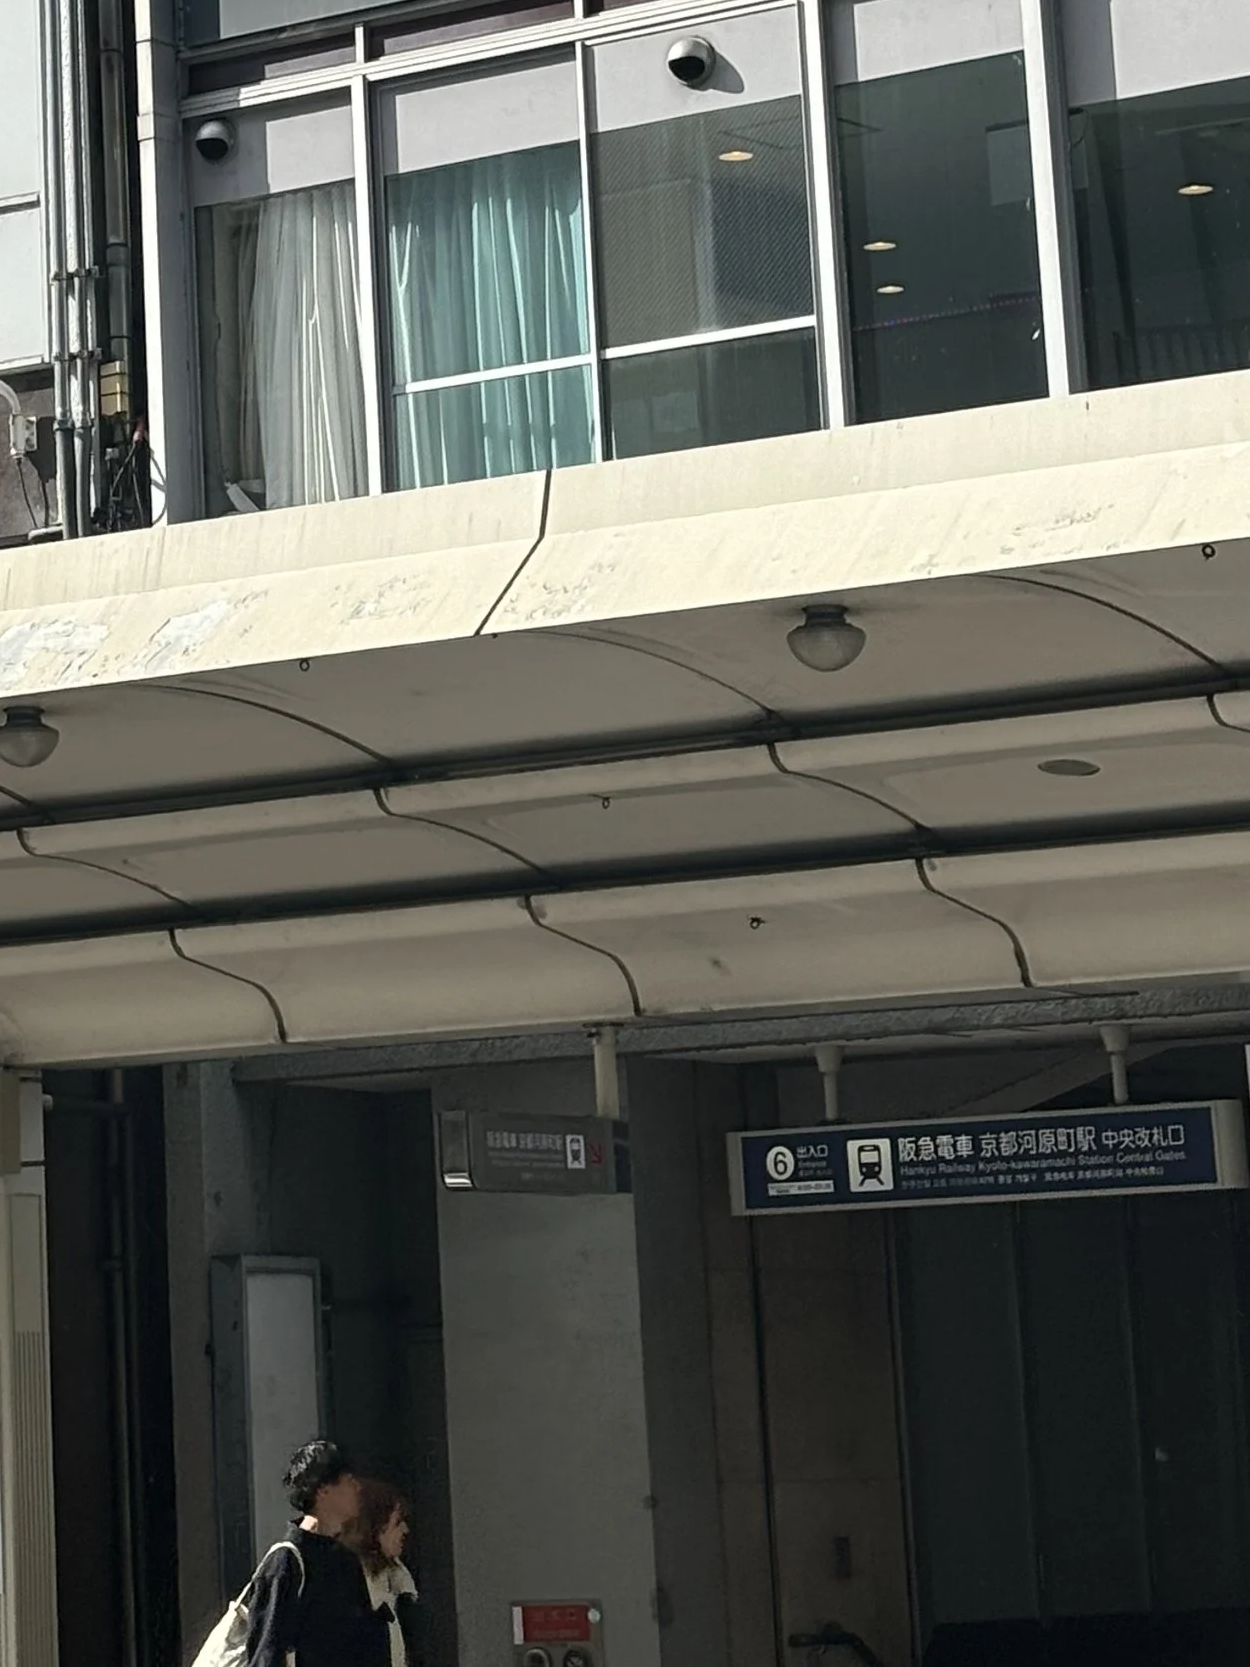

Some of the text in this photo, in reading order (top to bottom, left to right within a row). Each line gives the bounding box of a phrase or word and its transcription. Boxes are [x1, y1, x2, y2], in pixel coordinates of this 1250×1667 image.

[796, 1144, 829, 1159] 出入口
[898, 1124, 1186, 1163] 阪急電車 京都河原町駅 中央改札口
[772, 1151, 789, 1176] 6
[900, 1165, 936, 1176] Hankyu
[938, 1162, 976, 1175] Railway
[1078, 1154, 1114, 1166] Station
